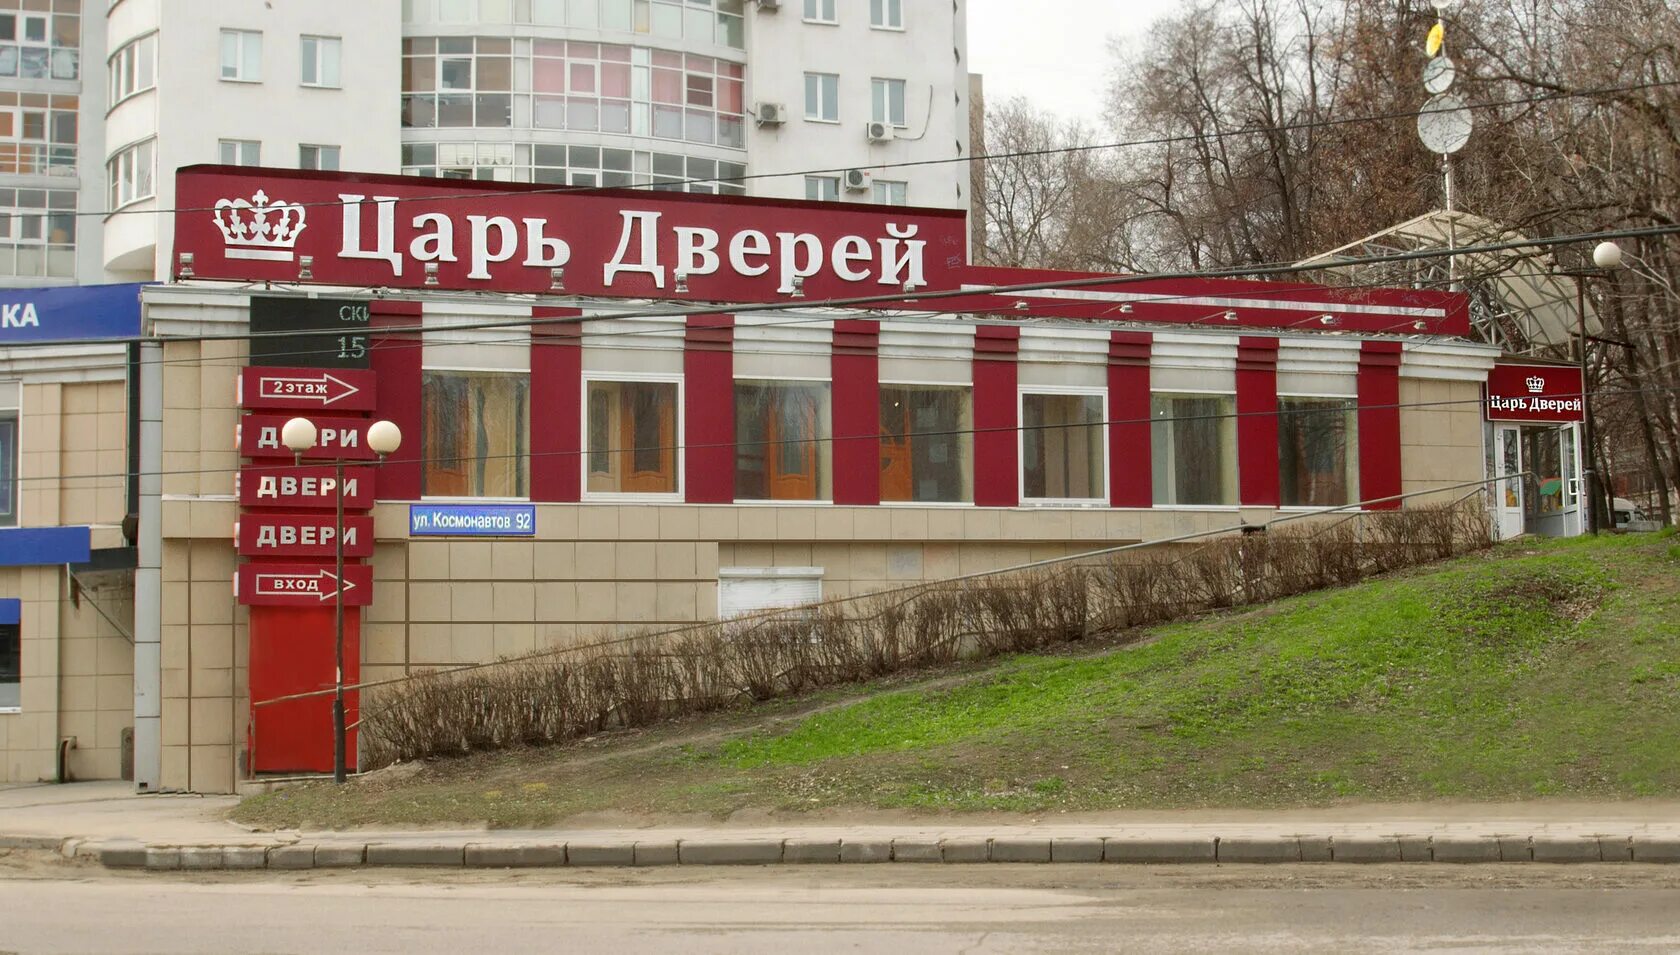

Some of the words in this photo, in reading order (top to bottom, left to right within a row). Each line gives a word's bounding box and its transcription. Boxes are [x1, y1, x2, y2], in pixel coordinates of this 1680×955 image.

[337, 193, 572, 280] Царь
[603, 209, 928, 294] Дверей
[337, 336, 365, 358] 15
[273, 381, 283, 393] 2
[285, 382, 328, 394] этаж
[1490, 395, 1527, 411] Царь
[1529, 398, 1581, 412] Дверей
[258, 426, 357, 448] ДРИ
[257, 476, 357, 498] ДВЕРИ
[413, 514, 431, 530] ул.
[433, 511, 511, 529] Космонавтов
[515, 513, 531, 530] 92
[256, 525, 357, 547] ДВЕРИ
